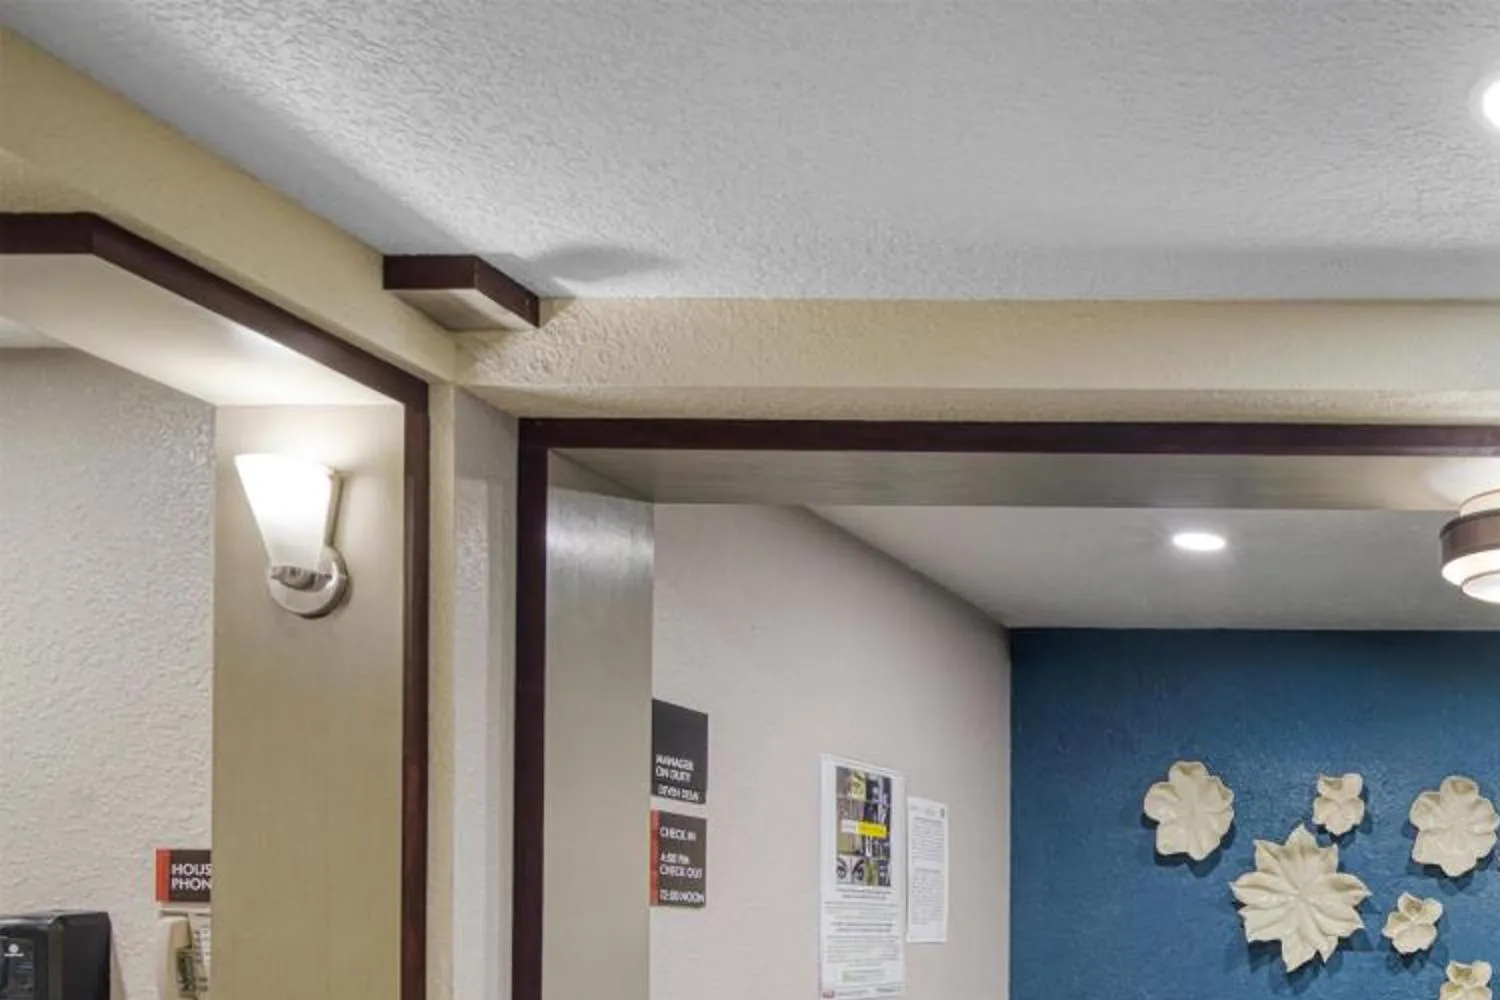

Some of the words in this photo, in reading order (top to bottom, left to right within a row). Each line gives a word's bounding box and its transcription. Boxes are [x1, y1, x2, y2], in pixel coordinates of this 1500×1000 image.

[656, 766, 669, 778] ON
[660, 827, 686, 839] CHECK
[660, 864, 686, 877] CHECK
[687, 867, 703, 879] OUT
